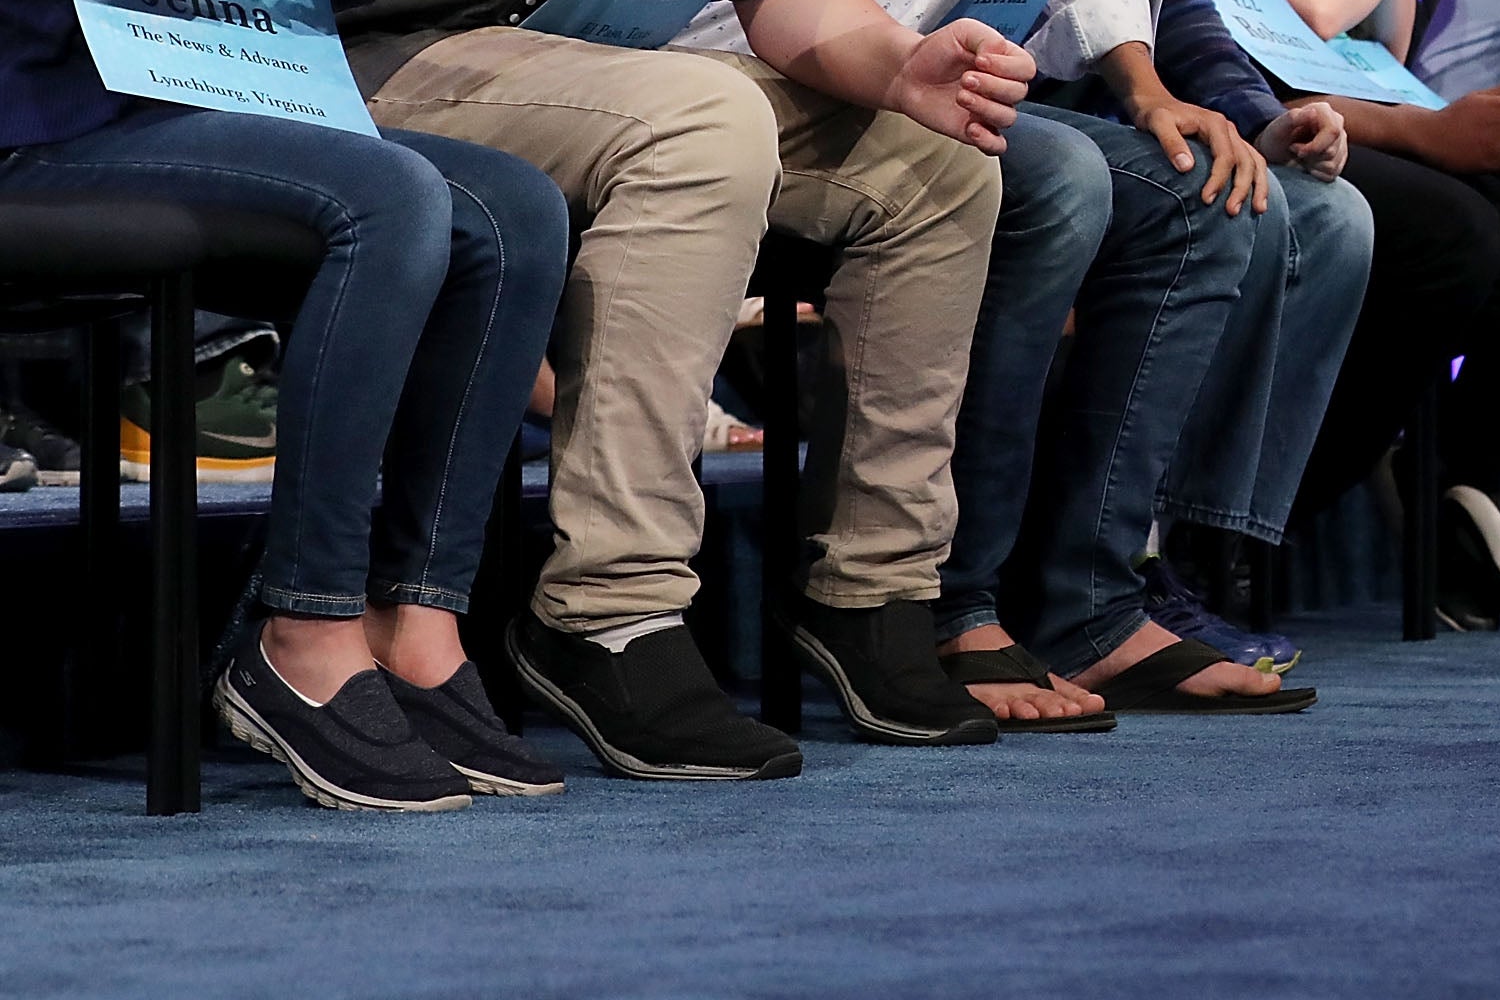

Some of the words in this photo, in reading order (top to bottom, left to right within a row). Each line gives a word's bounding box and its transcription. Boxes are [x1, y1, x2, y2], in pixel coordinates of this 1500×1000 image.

[127, 22, 163, 43] The
[167, 31, 214, 54] News
[219, 43, 234, 58] &
[240, 47, 309, 75] Advance
[149, 69, 250, 103] Lynchburg,
[251, 90, 327, 118] Virginia
